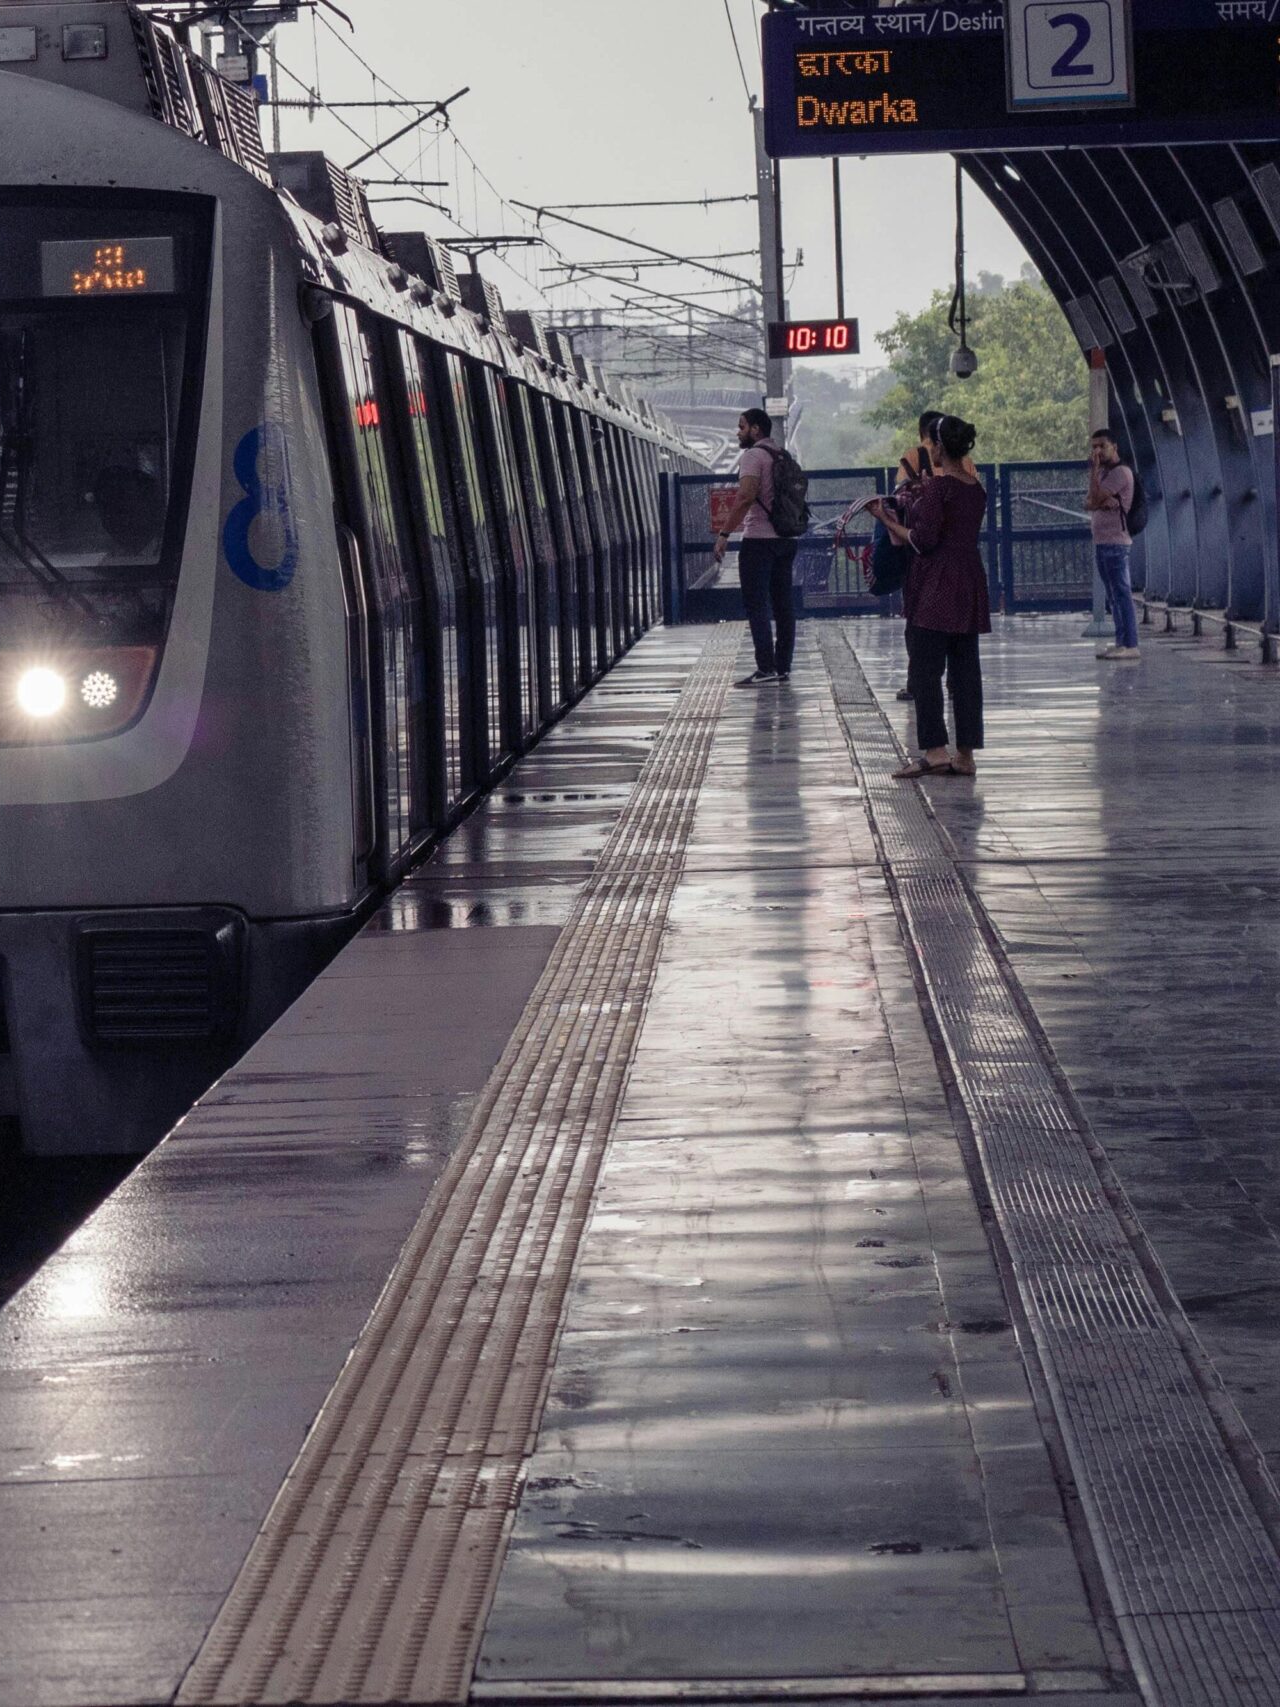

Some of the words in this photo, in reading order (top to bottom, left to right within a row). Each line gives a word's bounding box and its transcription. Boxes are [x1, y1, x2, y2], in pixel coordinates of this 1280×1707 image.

[796, 15, 866, 36] गन्तव्य
[871, 9, 1005, 35] स्थान/Destin
[1048, 12, 1094, 77] 2
[796, 50, 893, 77] द्वारका
[797, 92, 919, 126] Dwarka
[788, 325, 848, 351] 10:10
[222, 420, 300, 592] 8
